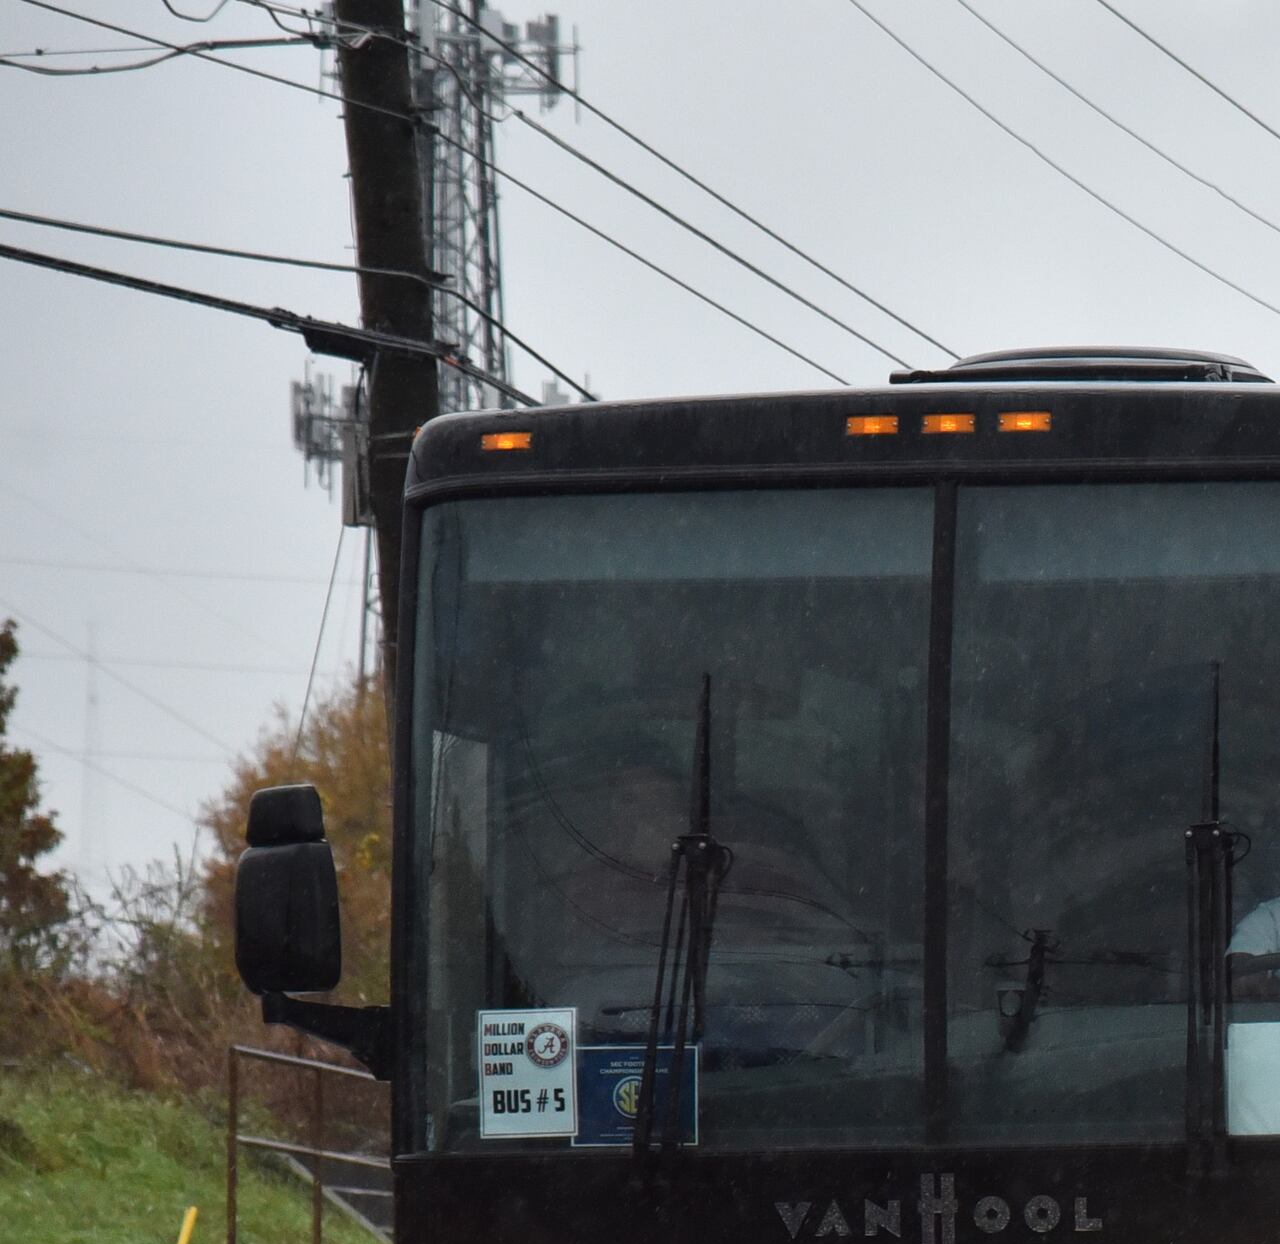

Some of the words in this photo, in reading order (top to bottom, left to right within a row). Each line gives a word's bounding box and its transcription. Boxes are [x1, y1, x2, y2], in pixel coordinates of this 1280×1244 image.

[484, 1022, 525, 1036] MILLION
[484, 1042, 524, 1056] DOLLAR
[484, 1062, 513, 1076] BAND
[493, 1089, 531, 1114] BUS
[554, 1088, 565, 1112] 5
